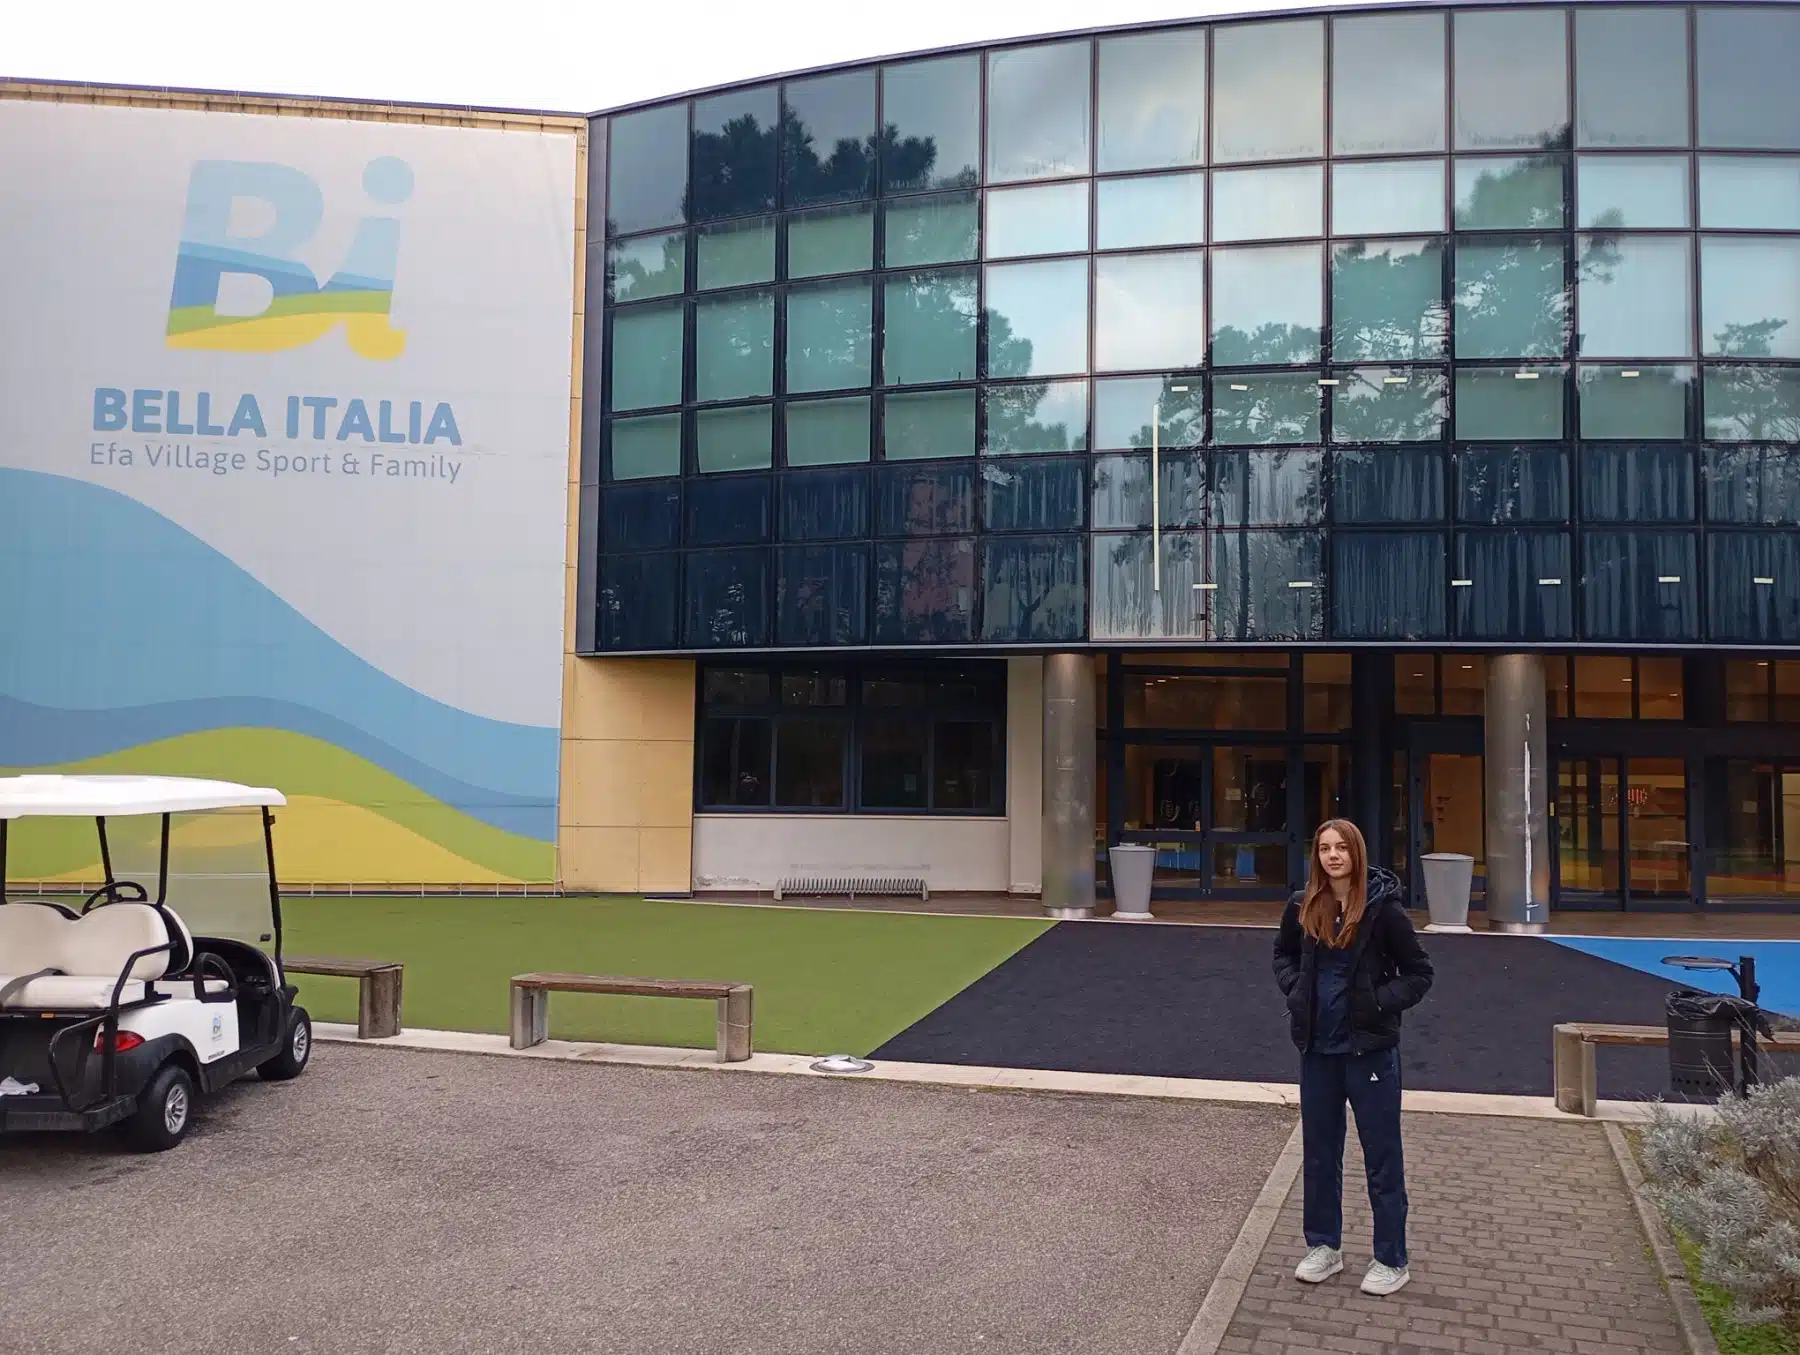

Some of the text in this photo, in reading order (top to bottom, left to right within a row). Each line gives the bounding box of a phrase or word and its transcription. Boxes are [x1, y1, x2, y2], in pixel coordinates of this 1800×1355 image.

[92, 387, 463, 447] BELLA ITALIA
[90, 443, 463, 485] Efa Village Sport & Family
